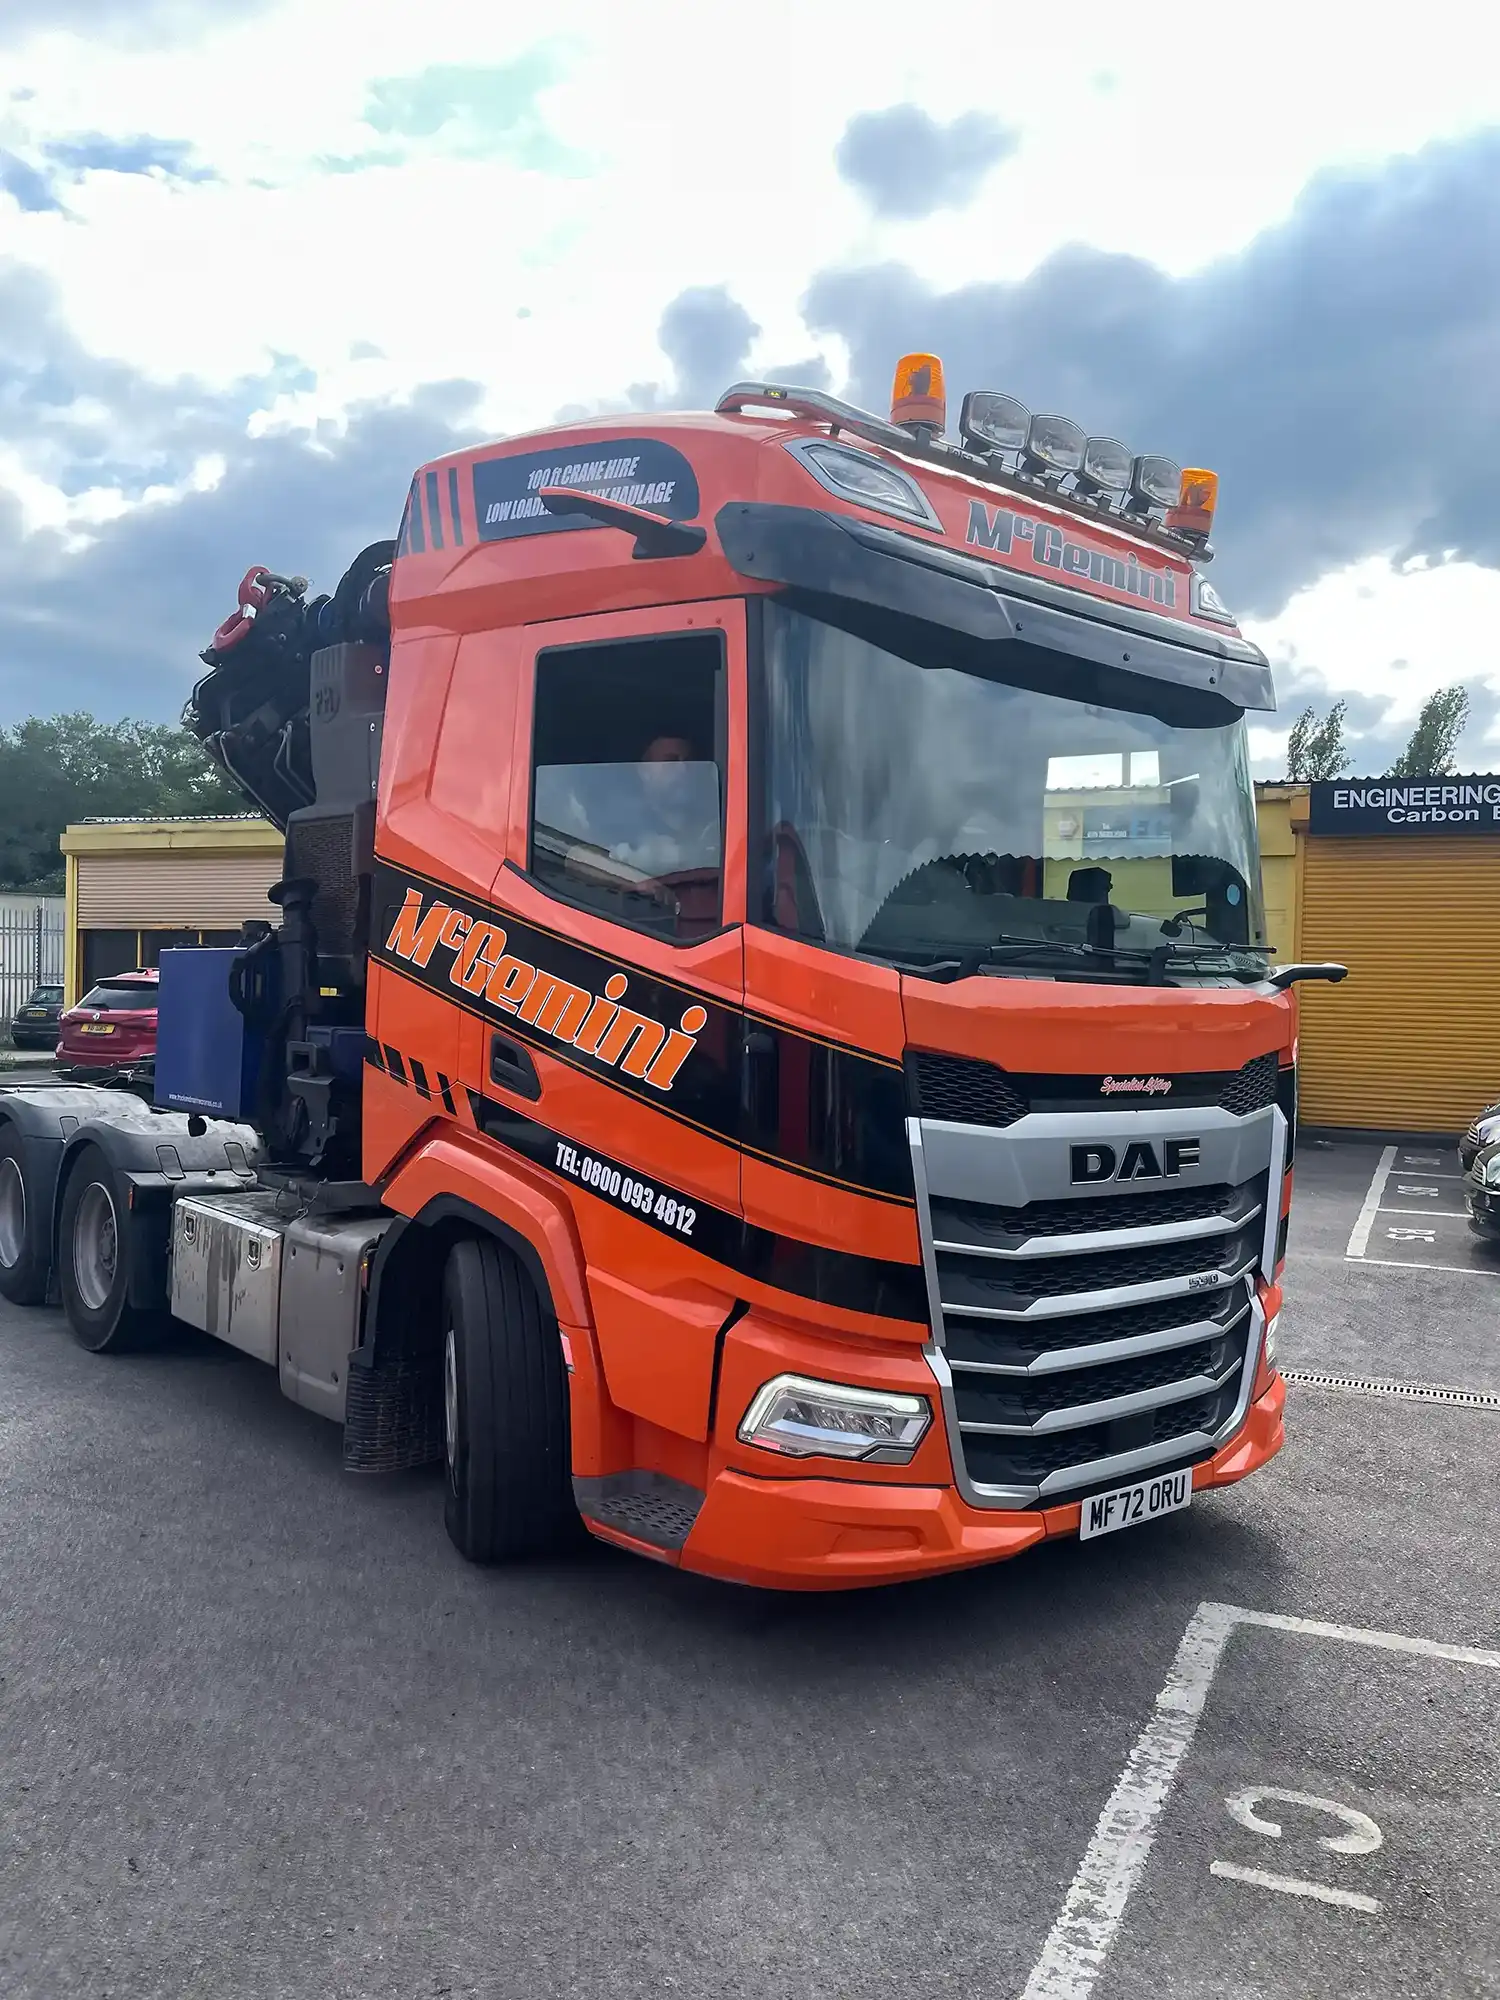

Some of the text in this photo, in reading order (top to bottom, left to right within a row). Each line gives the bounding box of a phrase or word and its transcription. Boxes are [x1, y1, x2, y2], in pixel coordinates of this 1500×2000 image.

[527, 469, 552, 490] 100
[561, 461, 605, 485] CRANE
[604, 456, 640, 479] HIRE
[485, 501, 513, 524] LOW
[609, 481, 677, 505] HAULAGE
[966, 499, 1177, 609] McGemini
[1333, 784, 1500, 809] ENGINEERING
[1387, 807, 1479, 823] Carbon
[385, 887, 708, 1091] McGemini
[1070, 1136, 1200, 1185] DAF
[555, 1142, 697, 1236] TEL: 0800 093 4812
[1090, 1475, 1186, 1531] MF72 ORU
